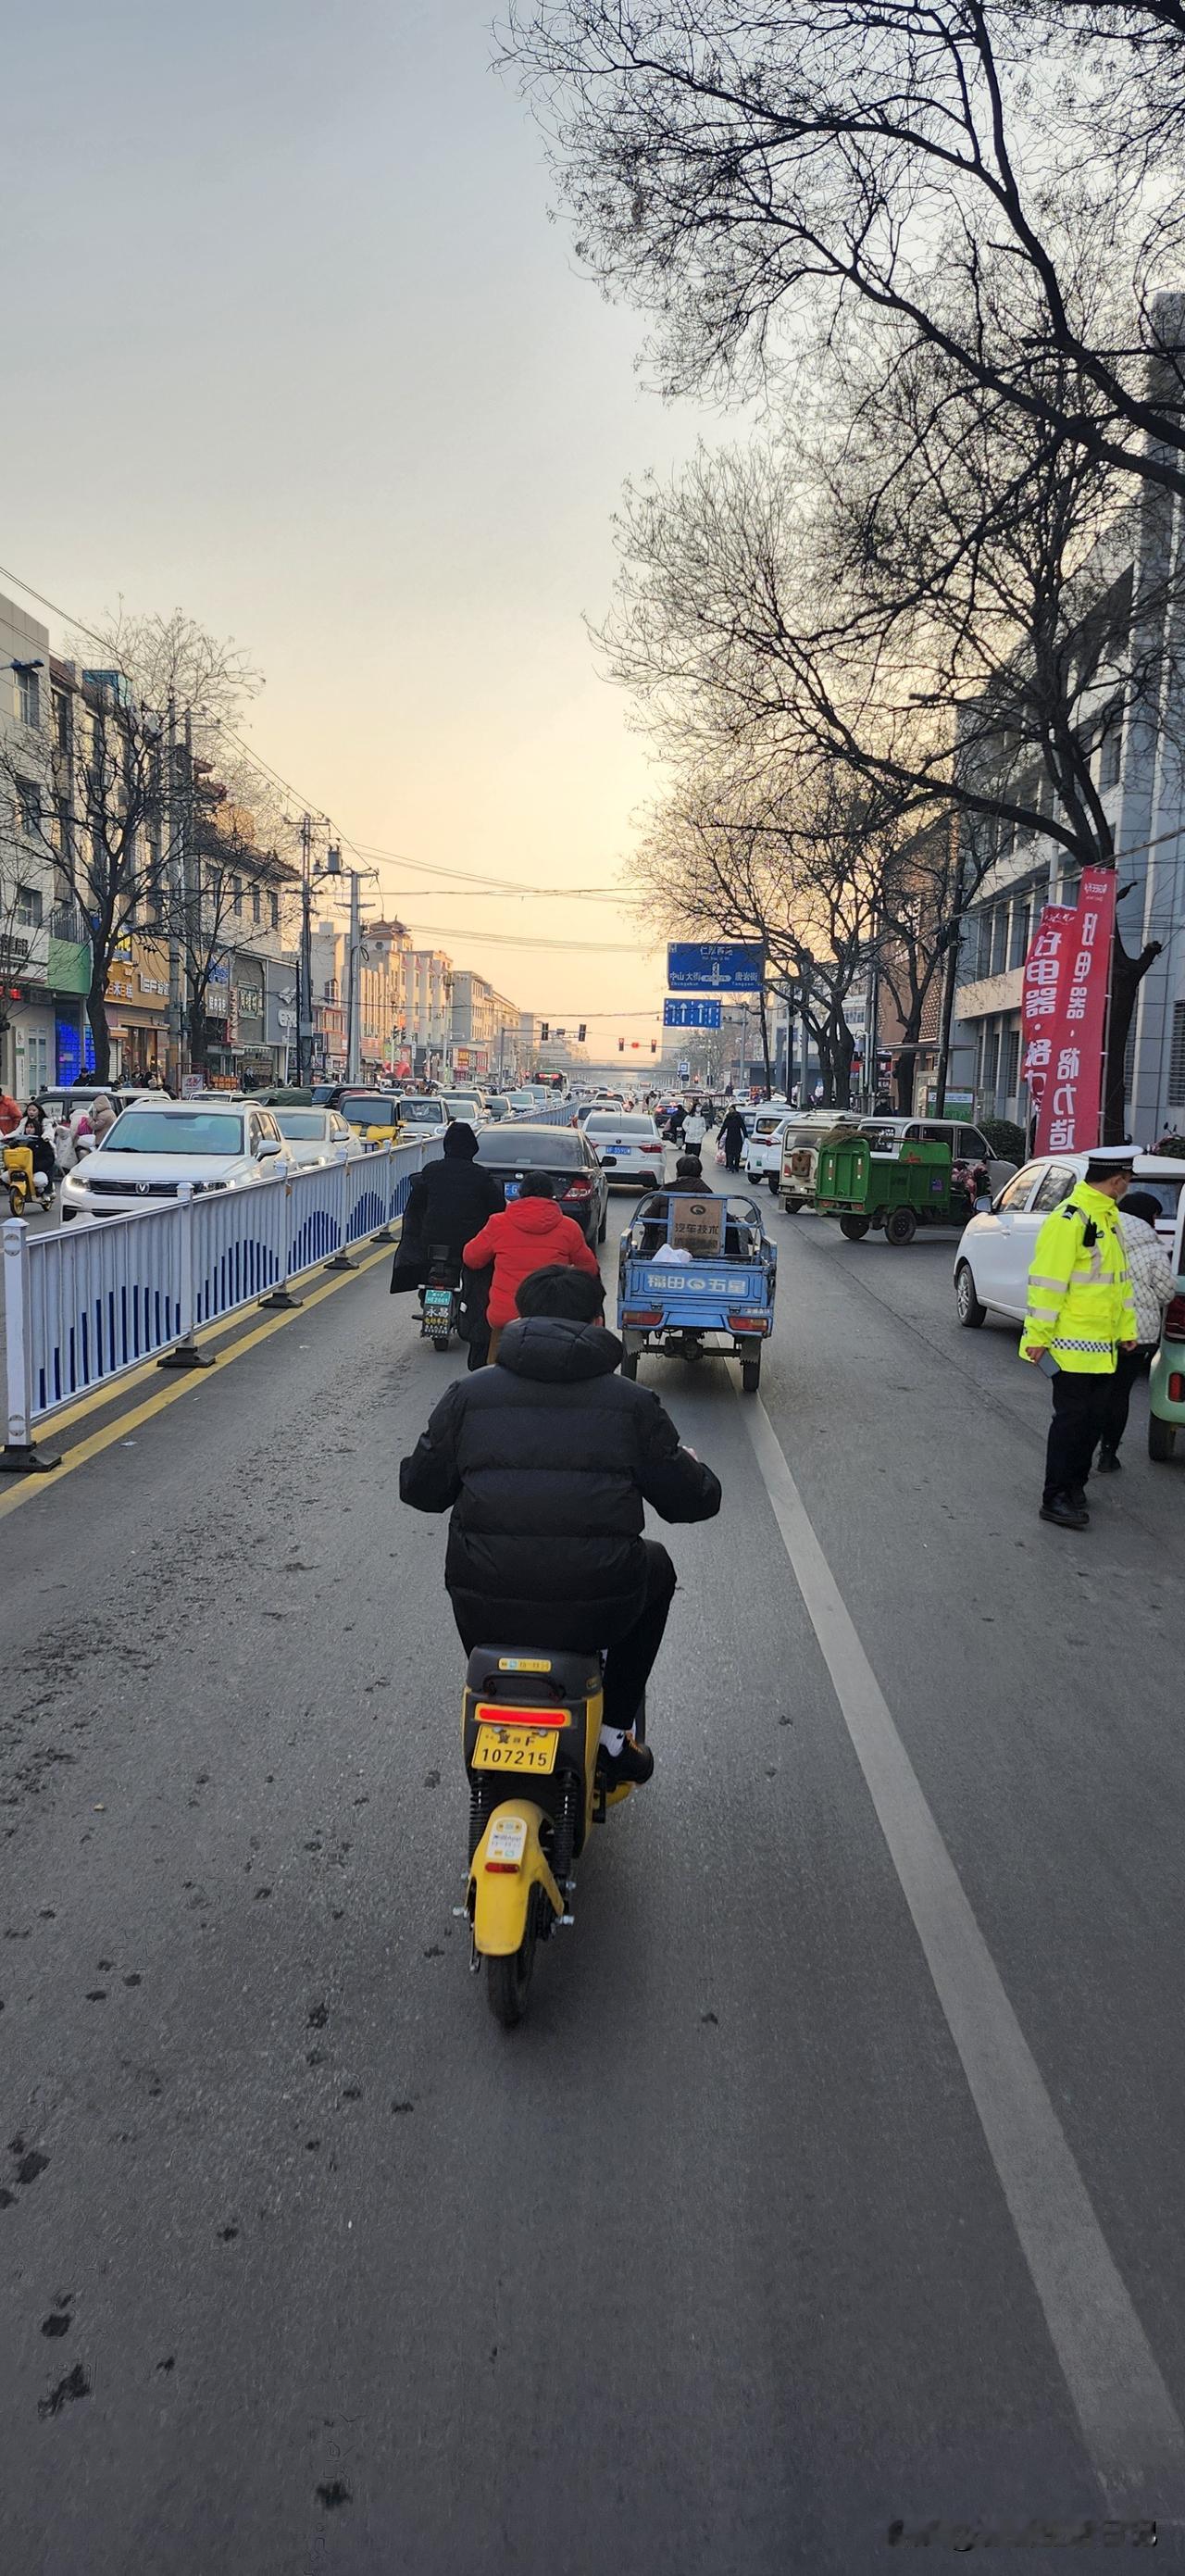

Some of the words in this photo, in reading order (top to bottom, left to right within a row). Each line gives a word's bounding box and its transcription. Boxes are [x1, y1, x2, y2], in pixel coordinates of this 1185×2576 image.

[669, 971, 702, 982] 中山大街
[674, 1222, 719, 1234] 汽车技术
[648, 1274, 685, 1289] 福田
[708, 1278, 746, 1294] 五星
[525, 1734, 536, 1746] F
[482, 1747, 548, 1767] 107215
